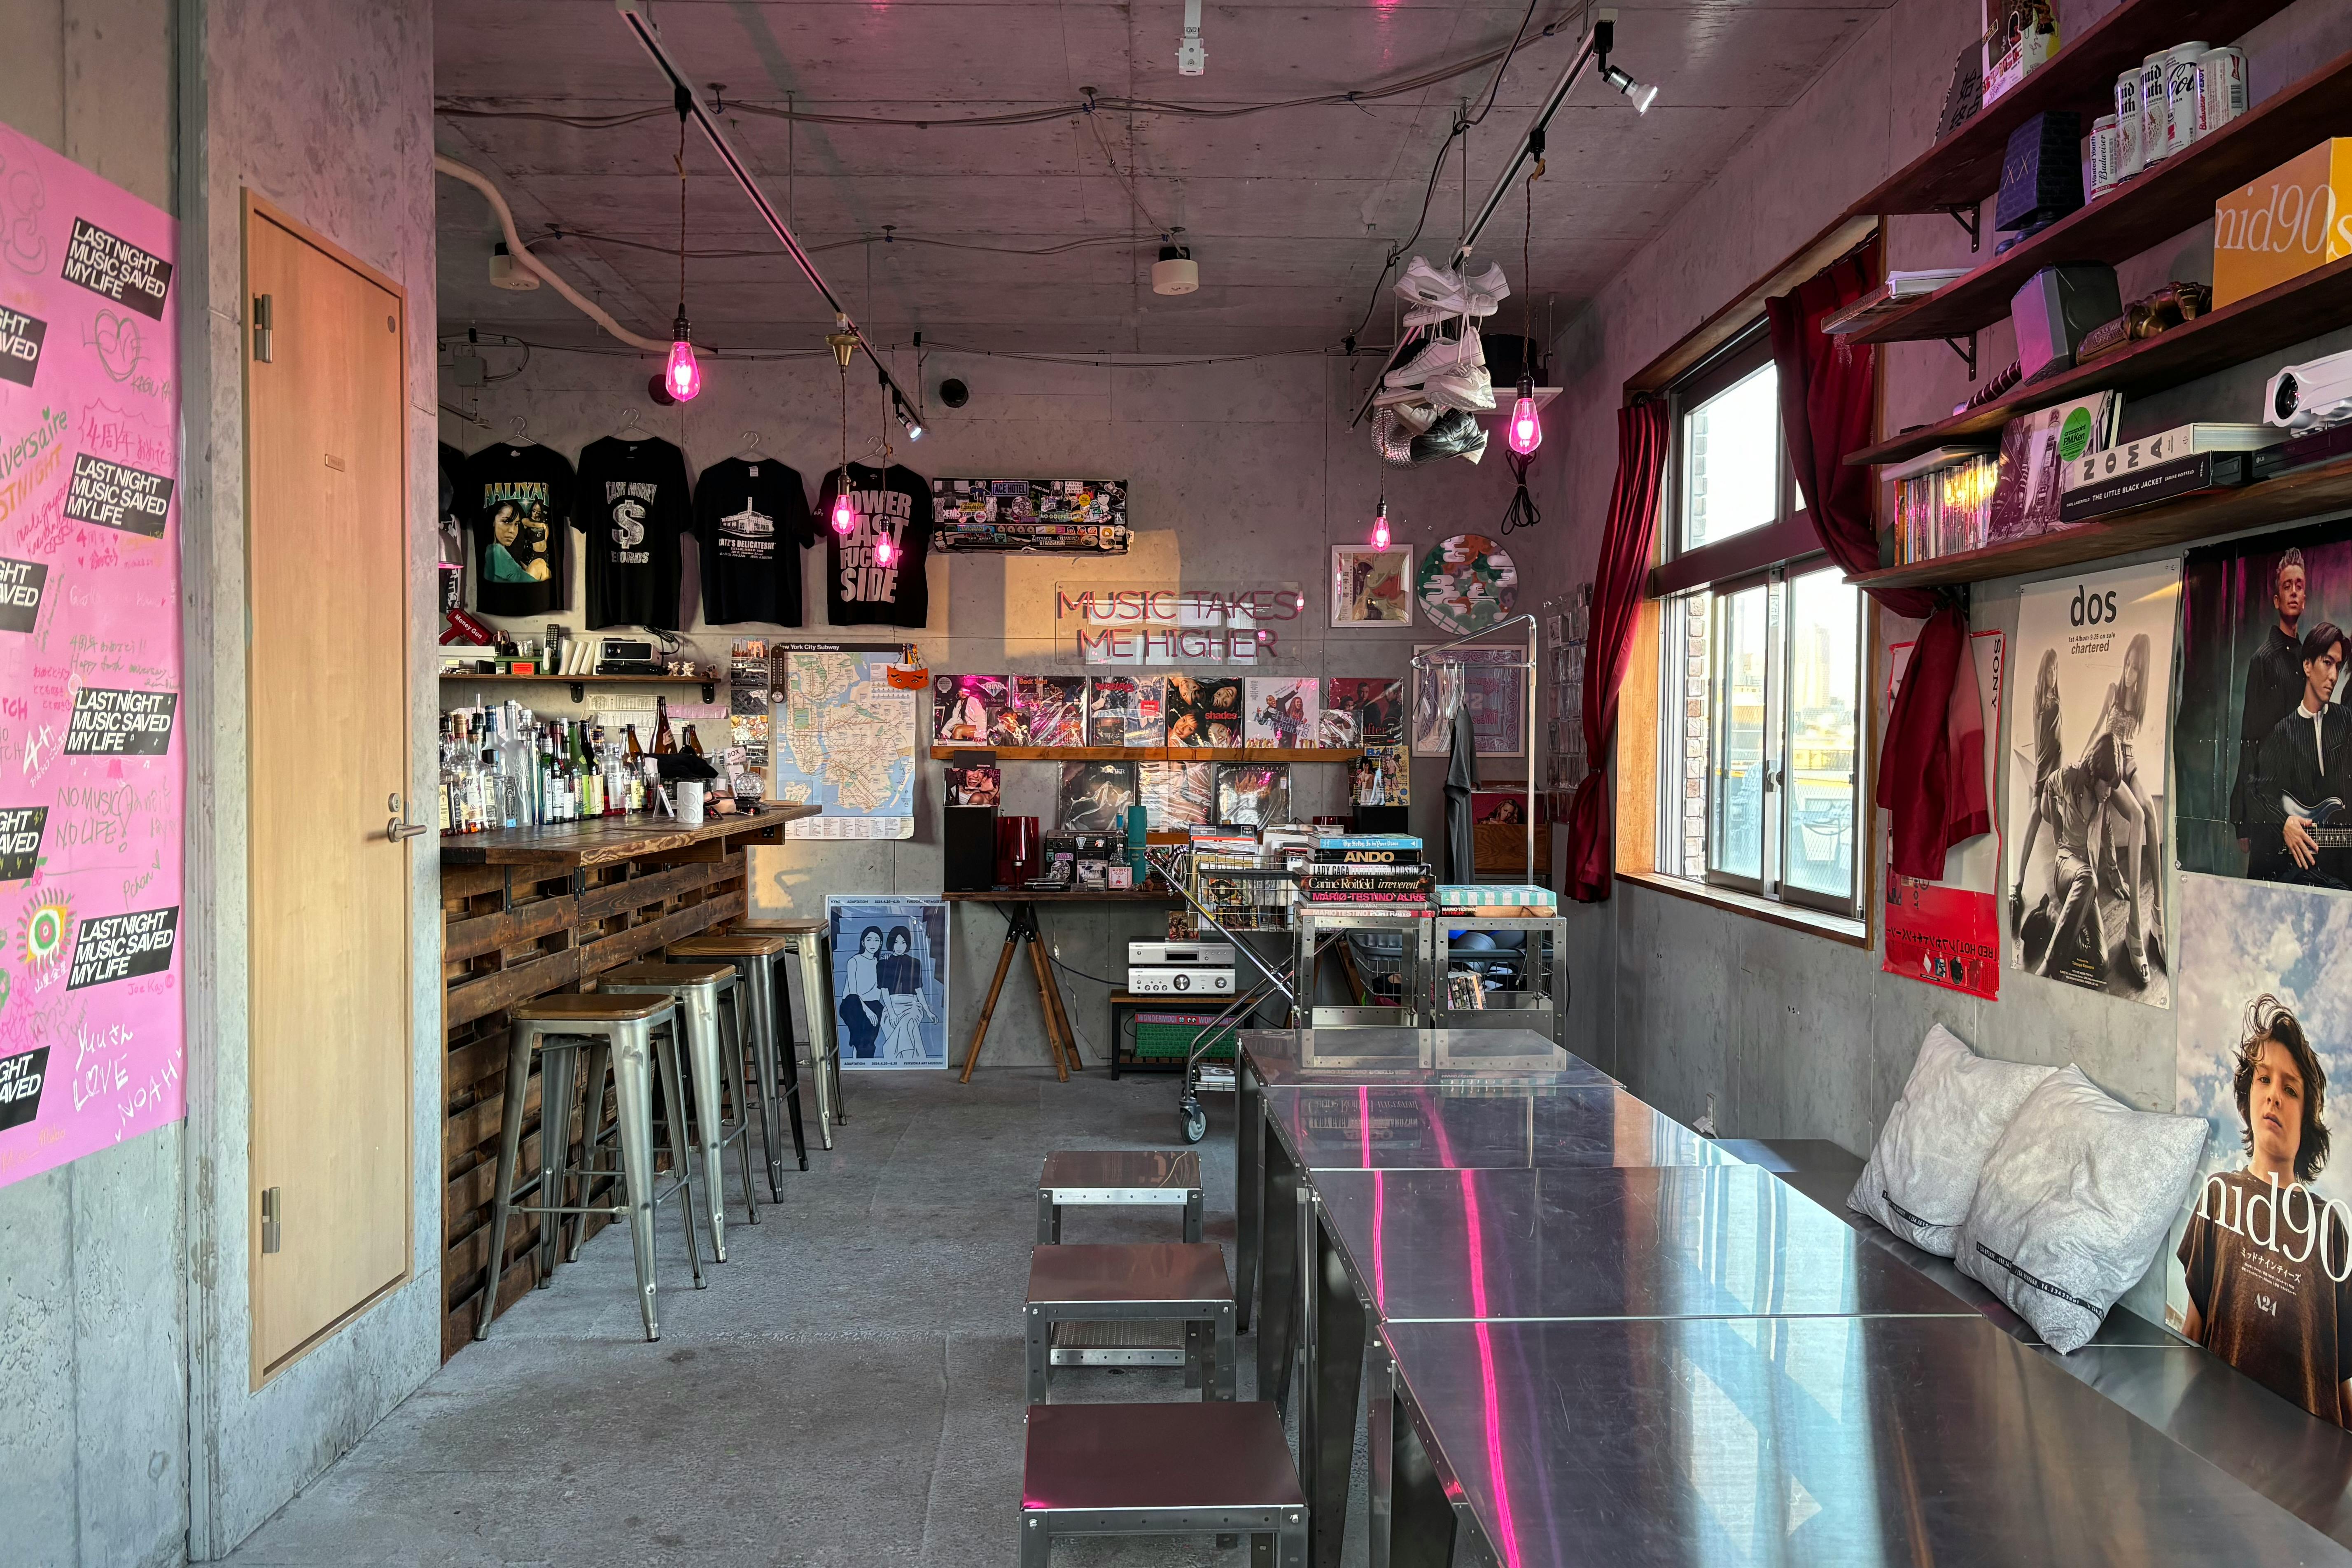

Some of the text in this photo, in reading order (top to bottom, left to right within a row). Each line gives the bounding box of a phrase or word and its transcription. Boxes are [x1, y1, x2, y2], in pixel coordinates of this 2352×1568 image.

[1983, 42, 2023, 95] SPICE
[2099, 134, 2108, 184] Budweiser
[74, 222, 159, 275] LAST NIGHT
[65, 260, 123, 300] MY LIFE
[69, 241, 165, 299] MUSIC SAVED
[0, 309, 29, 337] GHT
[2064, 424, 2086, 436] crosspoint
[75, 456, 161, 495] LAST NIGHT
[995, 483, 1026, 494] ACE HOTEL
[2104, 488, 2121, 499] LITTLE
[2122, 483, 2140, 494] BLACK
[2141, 477, 2163, 489] JACKET
[71, 476, 167, 516] MUSIC SAVED
[606, 481, 657, 506] CASH MONEY
[849, 490, 912, 519] OWER
[67, 496, 124, 525] MY LIFE
[0, 560, 31, 584] GHT
[840, 567, 898, 604] SIDE
[1057, 590, 1299, 620] MUSIC TAKES
[2070, 584, 2117, 627] dos
[454, 614, 483, 640] Money Gun
[2075, 634, 2089, 642] Album
[1079, 628, 1278, 658] ME HIGHER
[2071, 639, 2109, 655] chartered
[1991, 638, 2000, 710] SONY
[75, 691, 163, 713] LAST NIGHT
[1204, 712, 1237, 720] shades
[72, 712, 171, 732] MUSIC SAVED
[1387, 723, 1395, 735] 7
[67, 731, 126, 751] MY LIFE
[727, 748, 740, 758] BOX
[57, 786, 79, 808] NO
[82, 787, 122, 817] MUSIC
[0, 810, 33, 832] GHT
[56, 819, 78, 851] NO
[1314, 865, 1330, 875] LADY
[1332, 865, 1349, 875] GAGA
[1344, 851, 1395, 862] ANDO
[1309, 877, 1420, 889] Carine Roitfeld irreverent
[79, 911, 168, 943] LAST NIGHT
[75, 929, 173, 964] MUSIC SAVED
[70, 963, 97, 986] MY
[95, 956, 131, 982] LIFE
[128, 982, 145, 996] Joe
[0, 1054, 34, 1081] GHT
[72, 1054, 128, 1112] LOVE
[118, 1063, 178, 1127] NOAH
[2241, 1247, 2302, 1283] ミッドナインティーズ
[2254, 1293, 2277, 1317] A24
